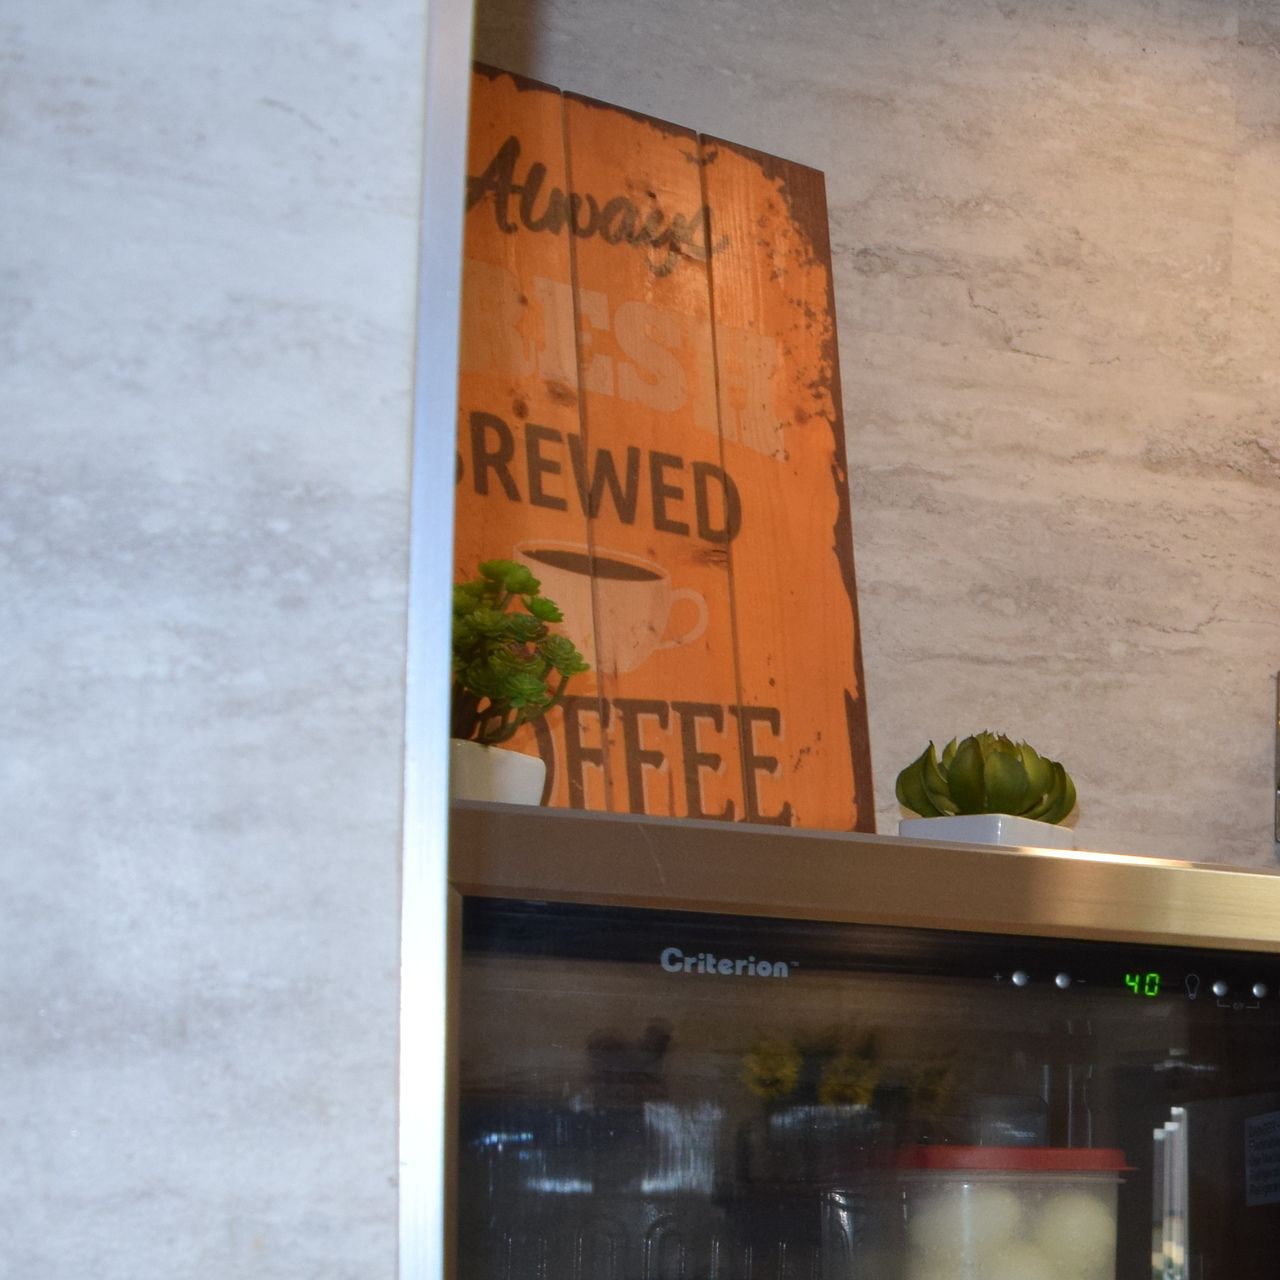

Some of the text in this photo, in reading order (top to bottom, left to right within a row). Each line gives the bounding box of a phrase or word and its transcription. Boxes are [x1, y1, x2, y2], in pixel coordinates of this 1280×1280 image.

[460, 259, 786, 458] RESH
[453, 410, 743, 543] REWED
[530, 695, 792, 827] FFEE
[660, 947, 789, 977] Criterion
[1125, 972, 1160, 996] 40
